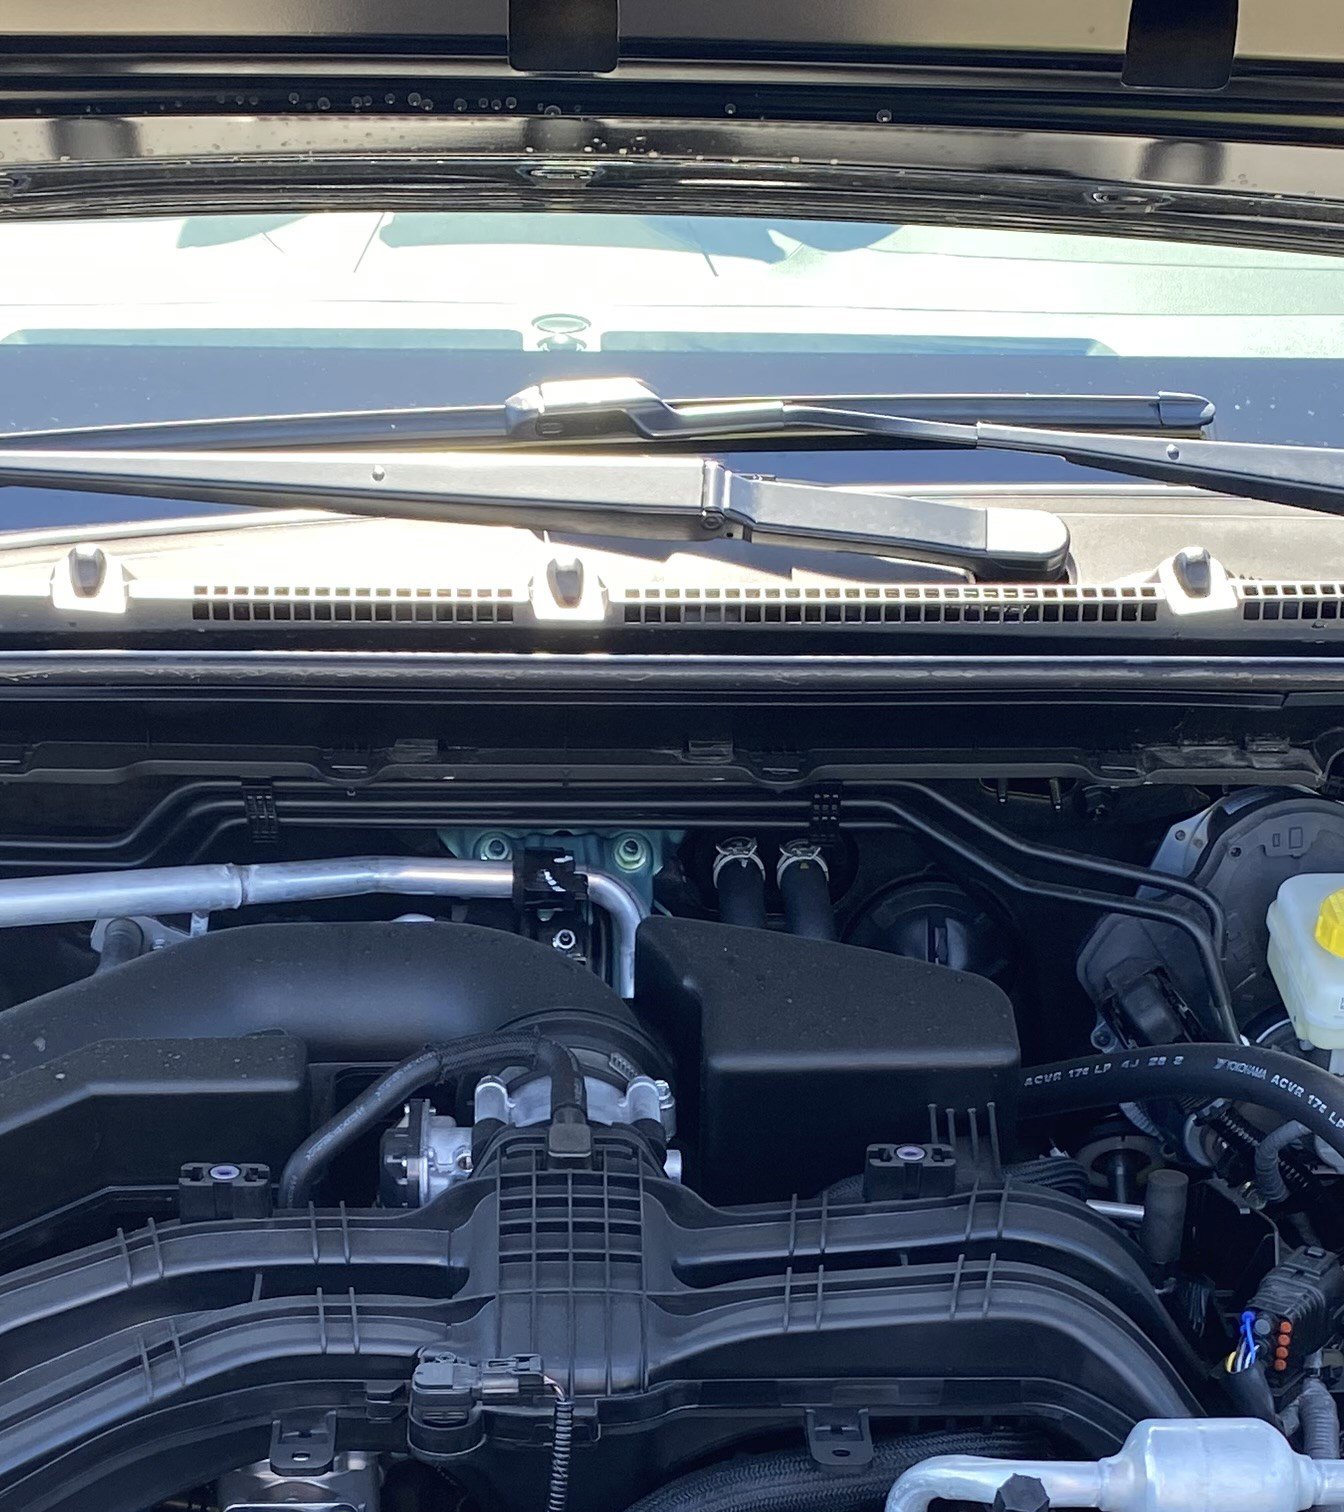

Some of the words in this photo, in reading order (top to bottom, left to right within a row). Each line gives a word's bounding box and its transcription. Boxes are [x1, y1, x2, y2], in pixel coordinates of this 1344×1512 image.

[1024, 1071, 1061, 1087] ACVR
[1094, 1062, 1112, 1074] LP
[1121, 1059, 1140, 1069] 4J
[1214, 1058, 1267, 1080] YOKOHAMA
[1271, 1075, 1304, 1098] ACVR
